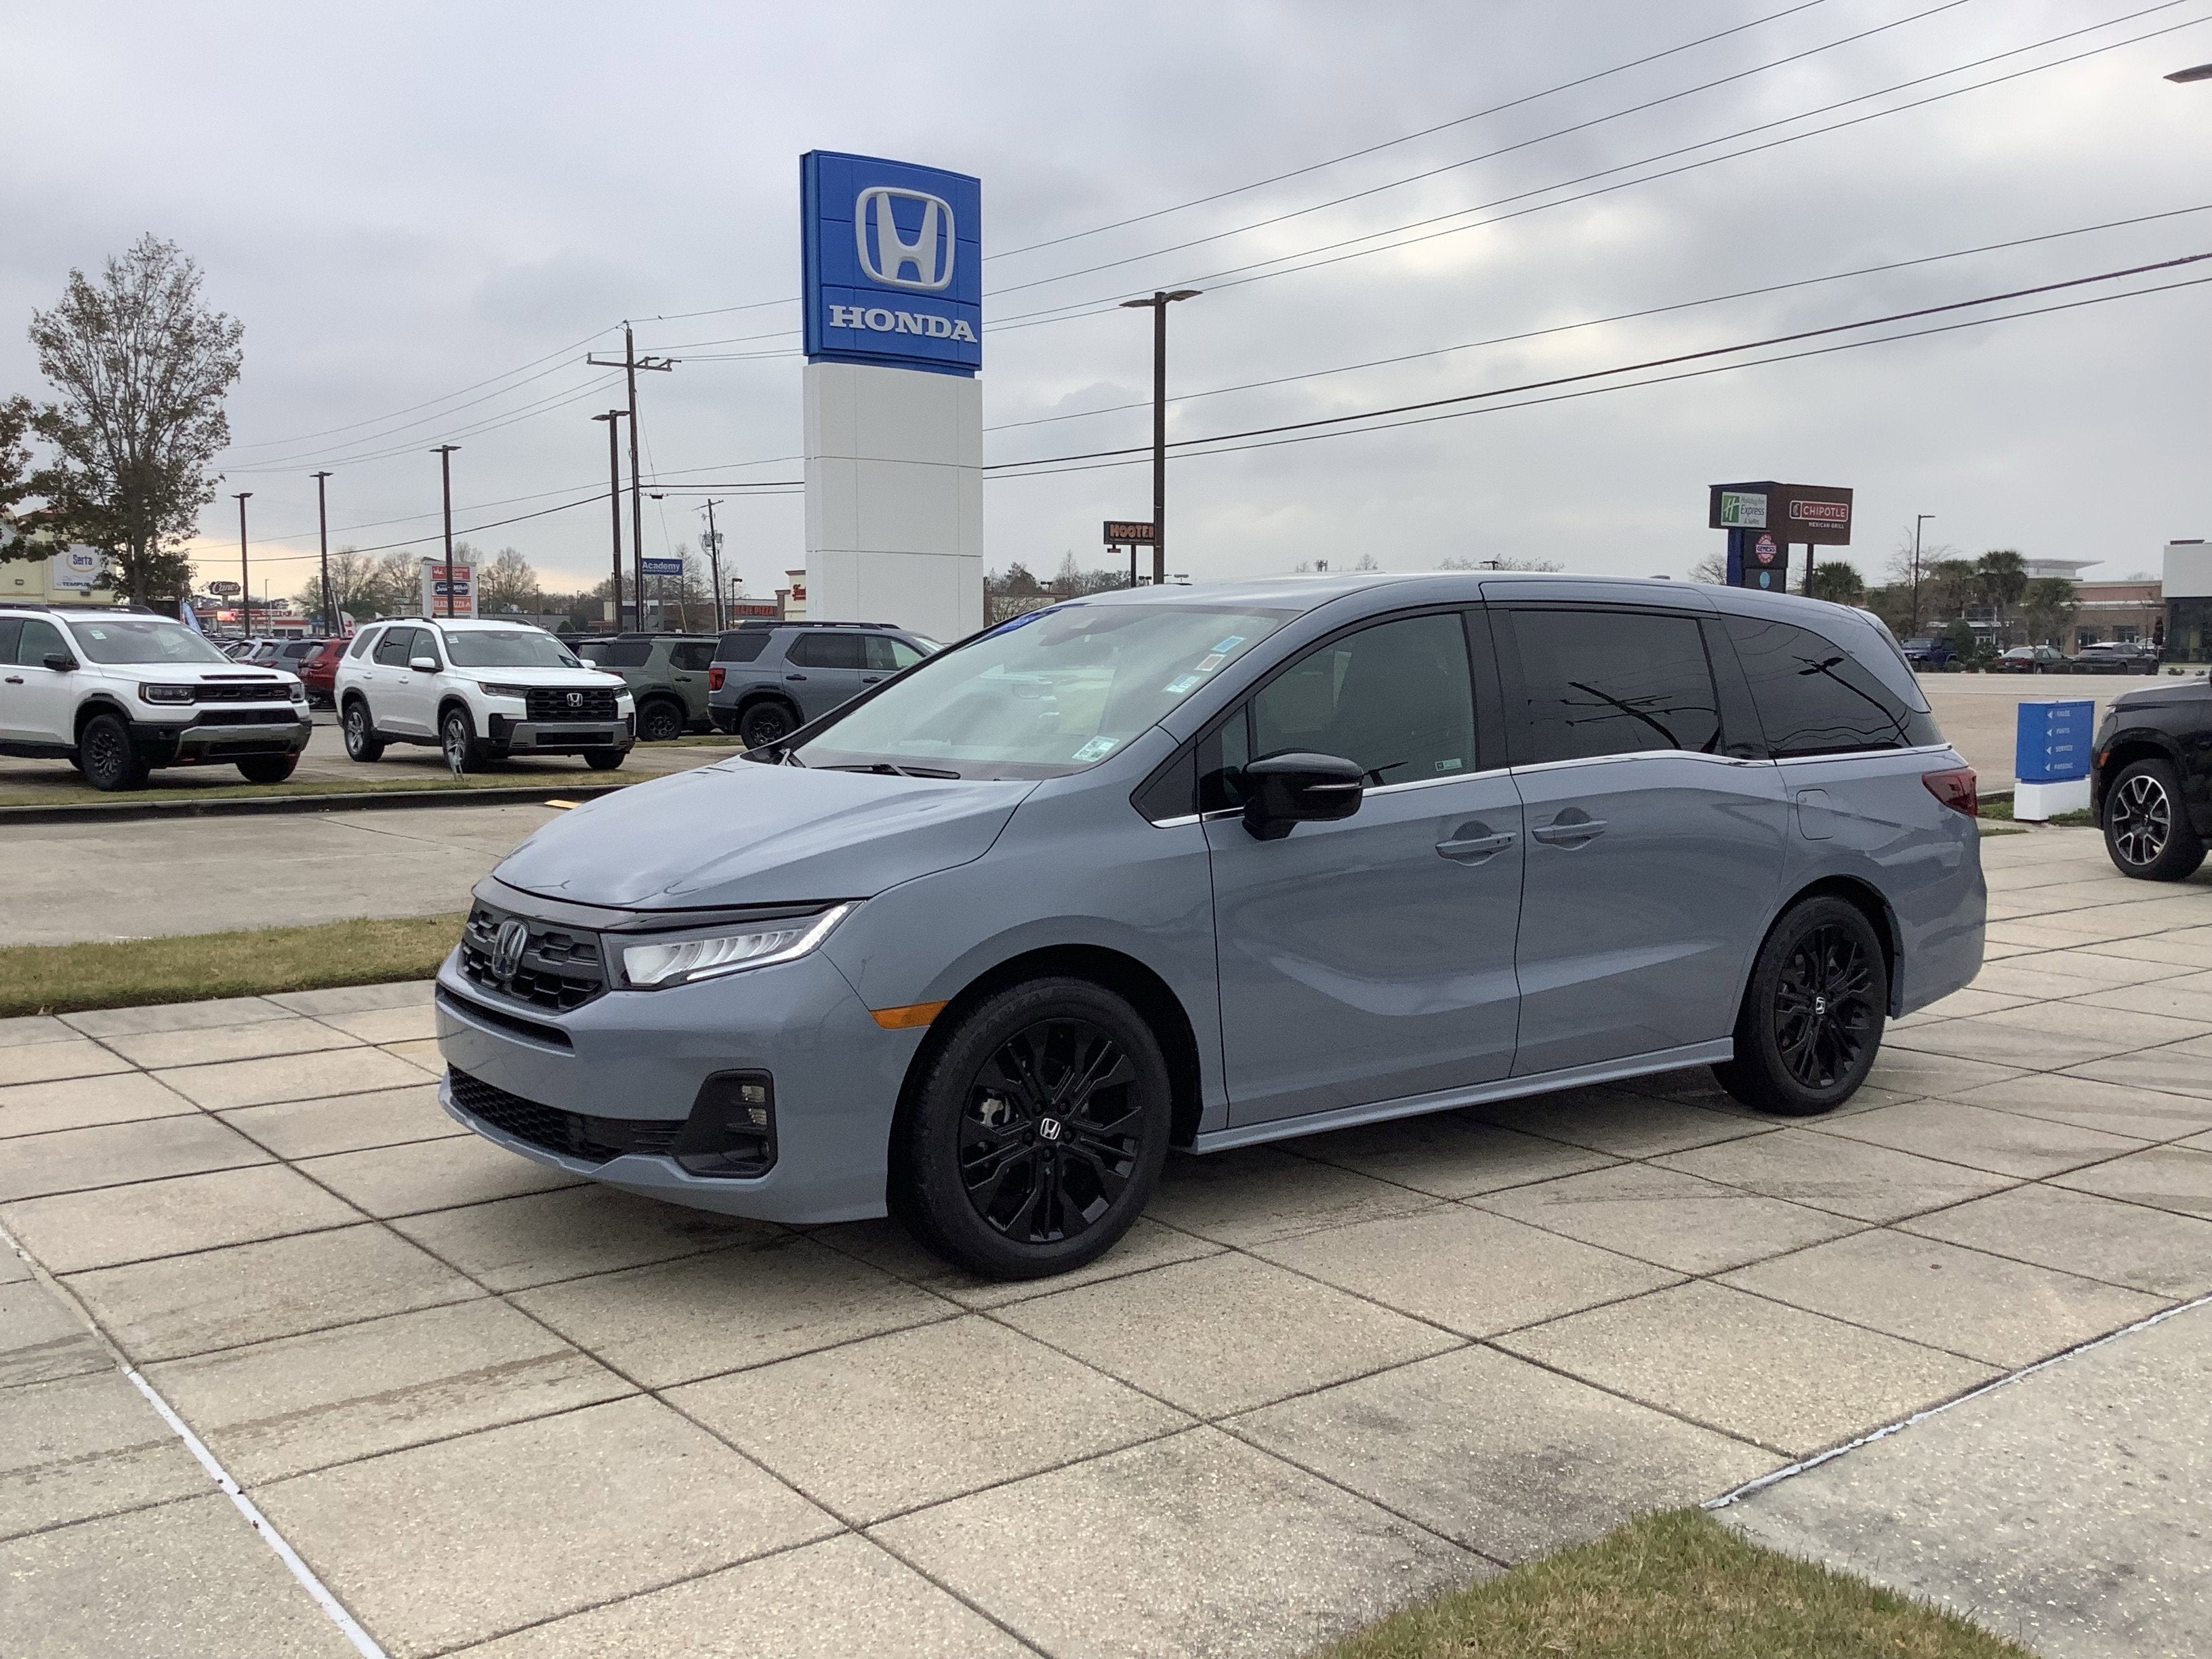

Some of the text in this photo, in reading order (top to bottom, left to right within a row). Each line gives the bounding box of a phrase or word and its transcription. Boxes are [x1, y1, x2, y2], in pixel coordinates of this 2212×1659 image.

[829, 304, 978, 344] HONDA
[1740, 504, 1765, 517] Express
[1803, 505, 1846, 518] CHIPOTLE
[1109, 524, 1154, 538] HOOTER
[73, 554, 93, 566] Serta
[642, 561, 680, 572] Academy
